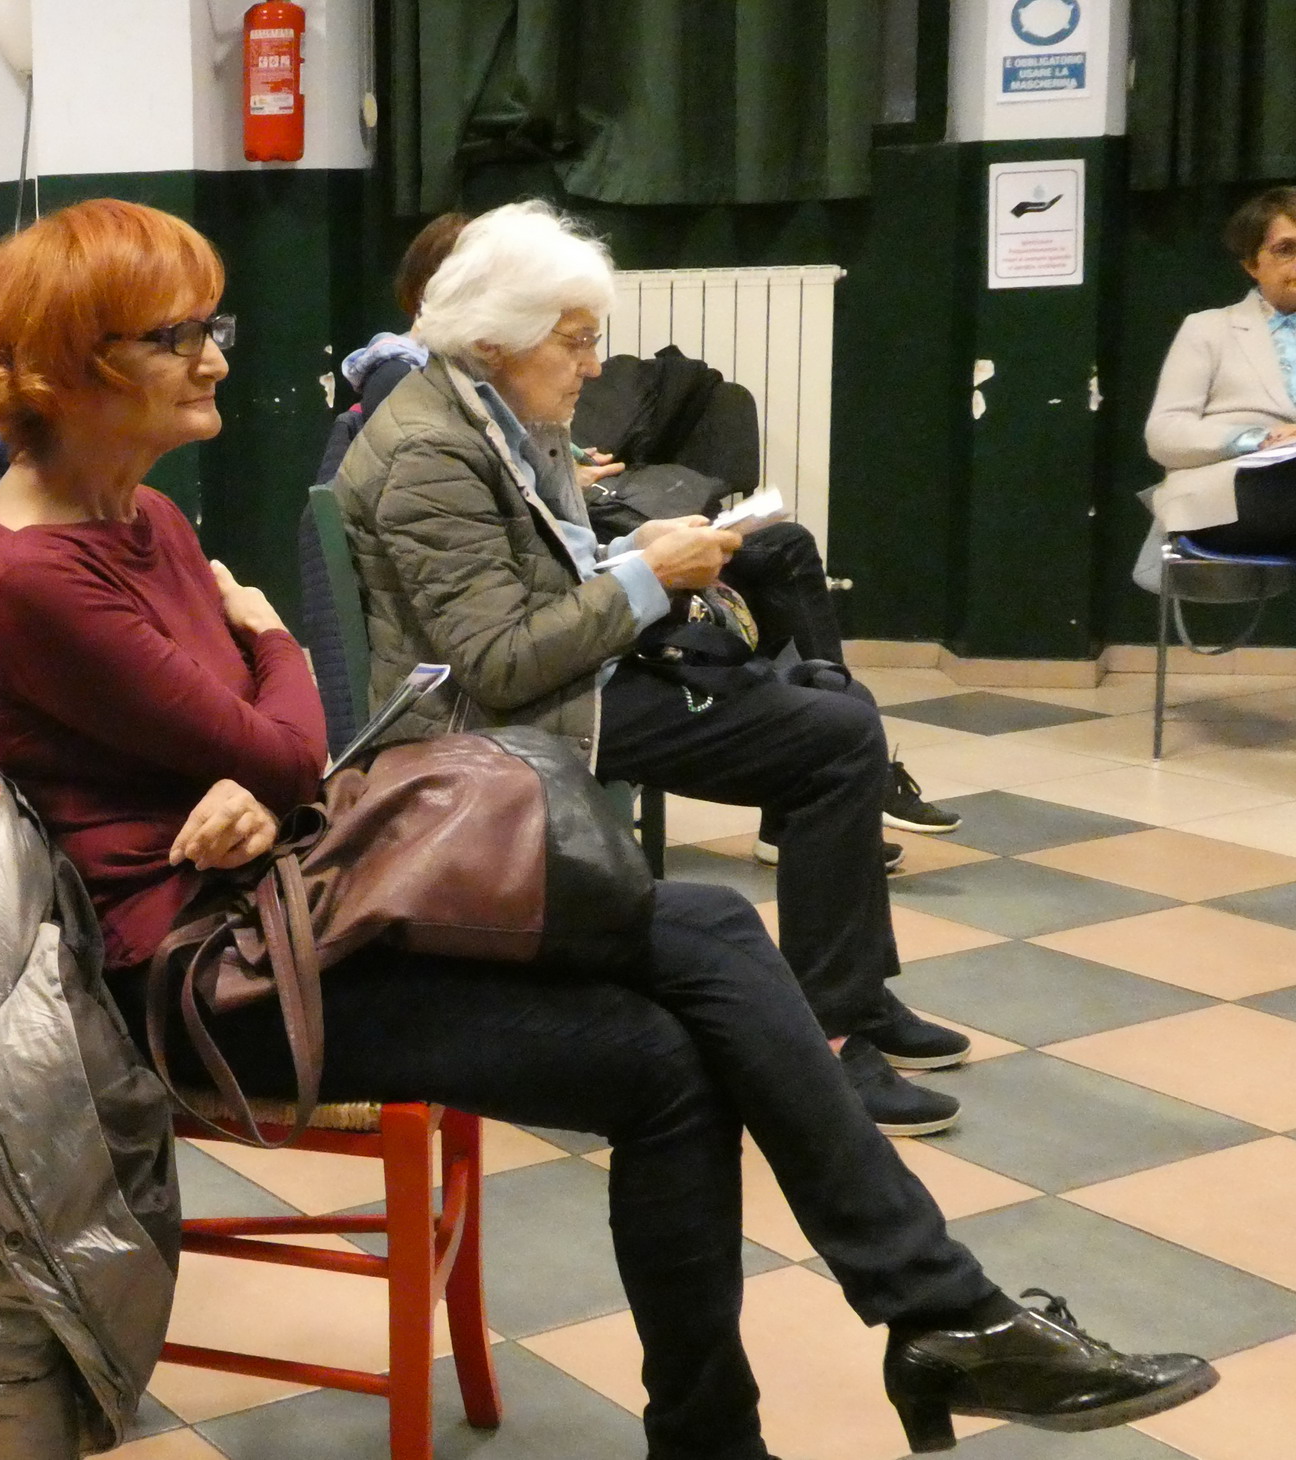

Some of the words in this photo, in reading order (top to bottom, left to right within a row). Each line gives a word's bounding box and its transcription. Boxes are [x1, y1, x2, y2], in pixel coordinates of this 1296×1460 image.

[1014, 55, 1083, 67] OBBLIGATORIO
[1019, 68, 1052, 78] USARE
[1055, 67, 1069, 77] LA
[1010, 78, 1078, 90] MASCHERINA
